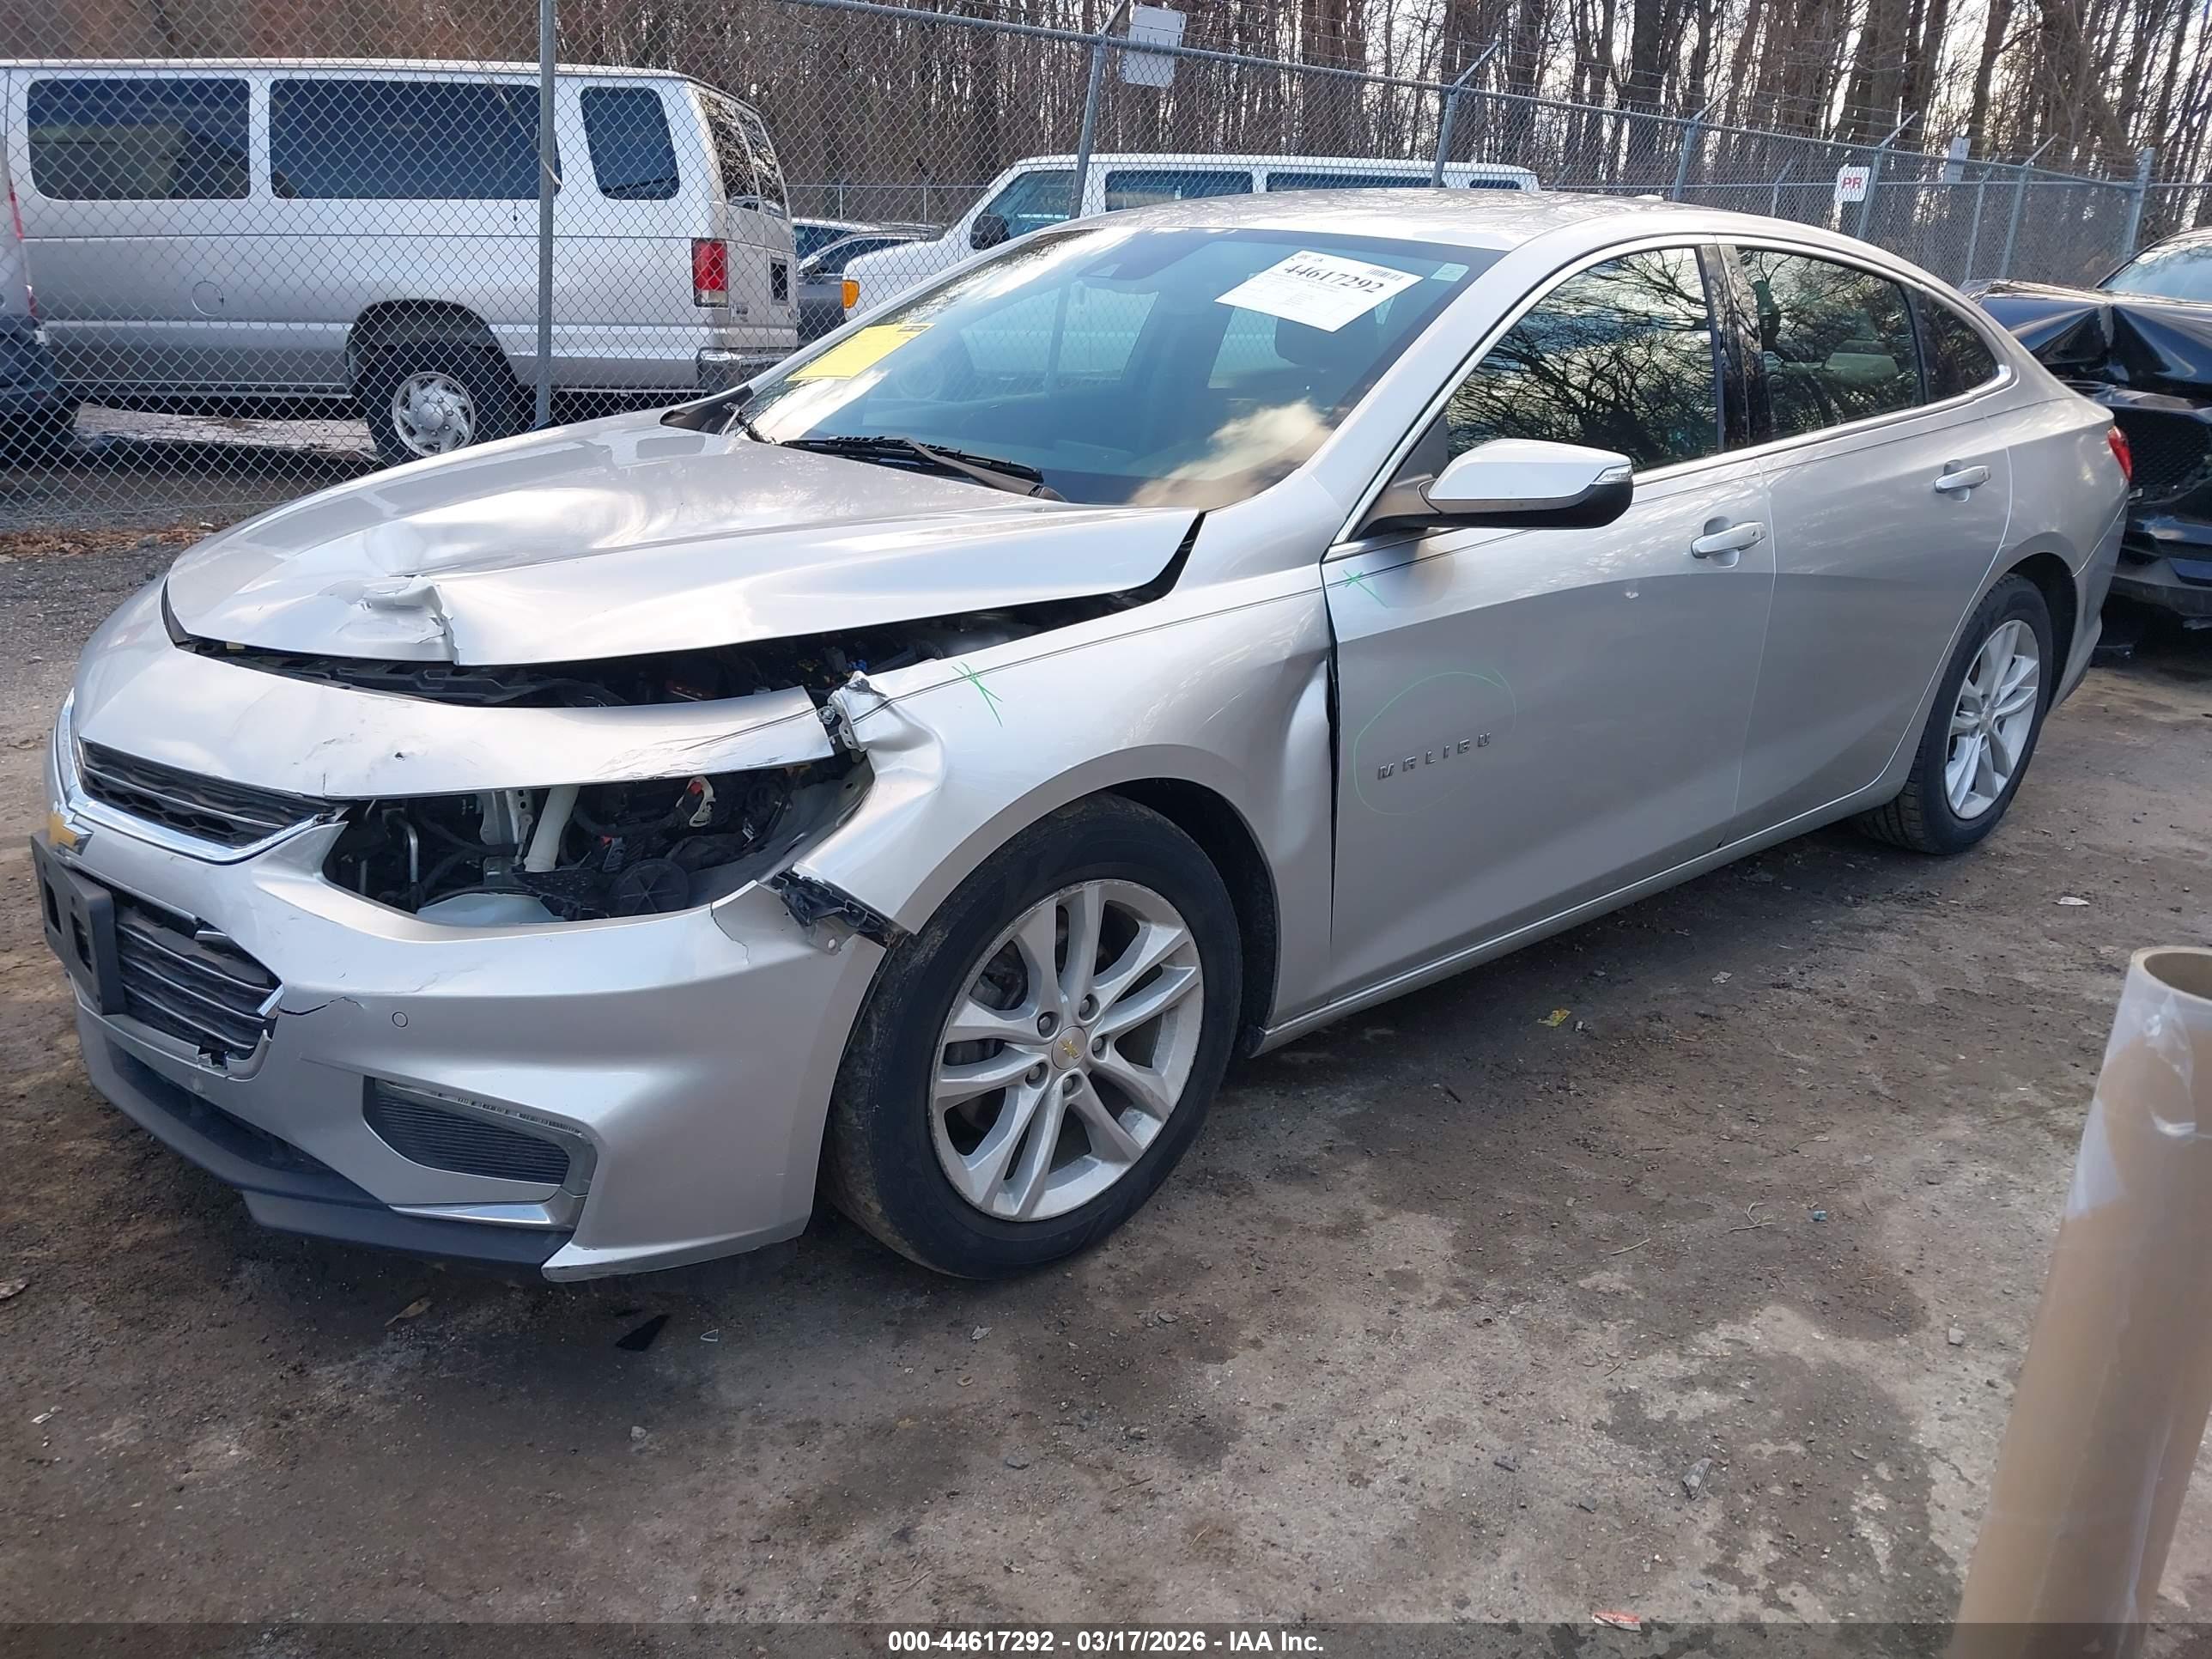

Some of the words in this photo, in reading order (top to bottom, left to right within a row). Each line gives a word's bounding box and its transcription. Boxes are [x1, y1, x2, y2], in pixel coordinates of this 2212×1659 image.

[1842, 177, 1863, 189] PR
[1284, 264, 1385, 294] 44617292
[1377, 732, 1491, 780] MALIBU
